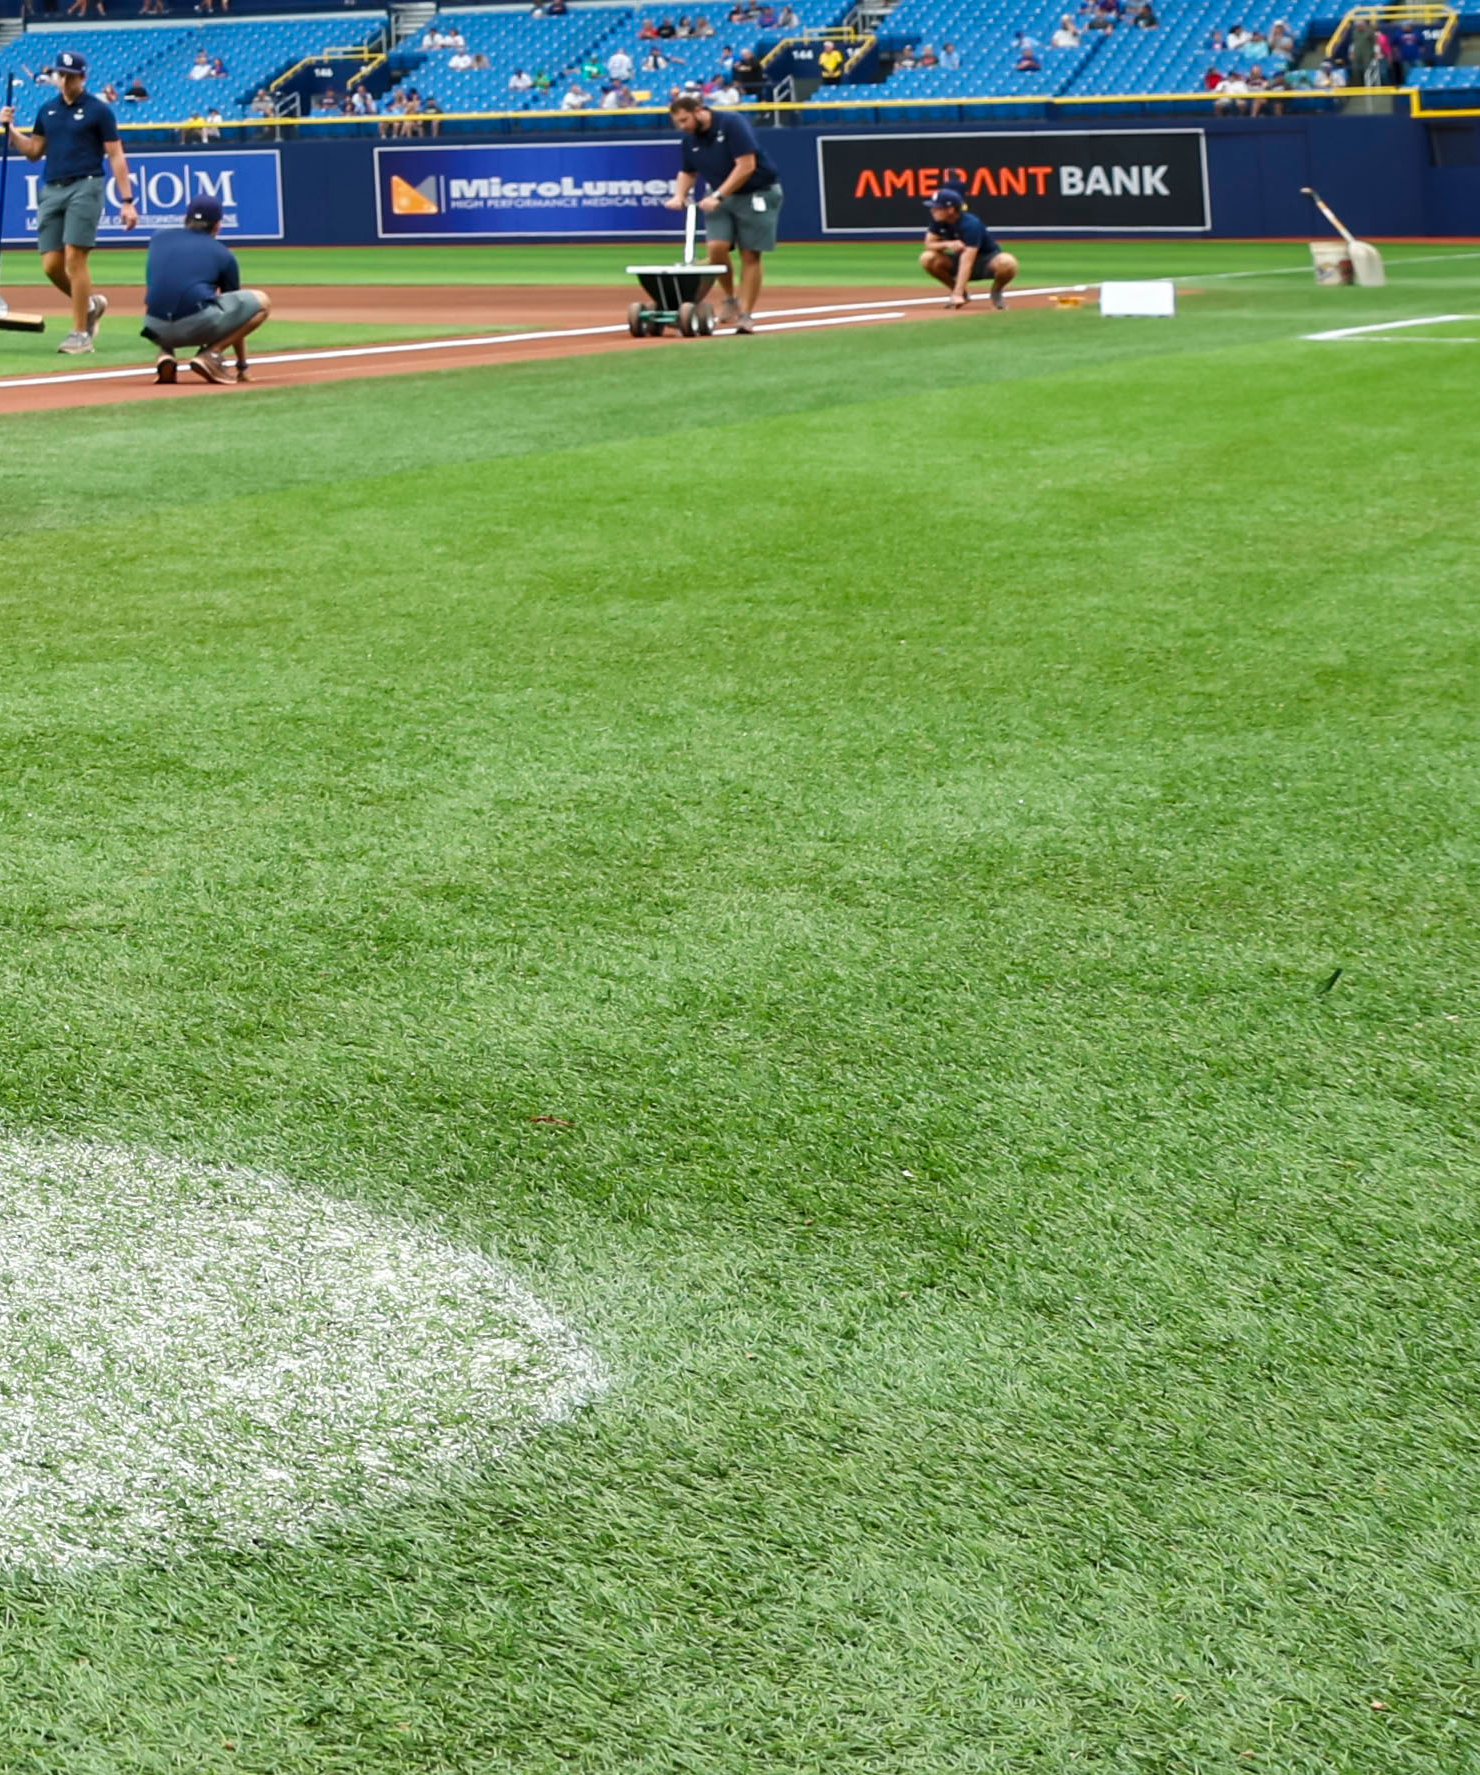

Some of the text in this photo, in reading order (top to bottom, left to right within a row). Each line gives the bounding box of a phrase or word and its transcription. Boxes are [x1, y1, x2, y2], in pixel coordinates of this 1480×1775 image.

[1060, 164, 1170, 197] BANK
[451, 195, 639, 210] HIGH PERFORMANCE MEDICAL
